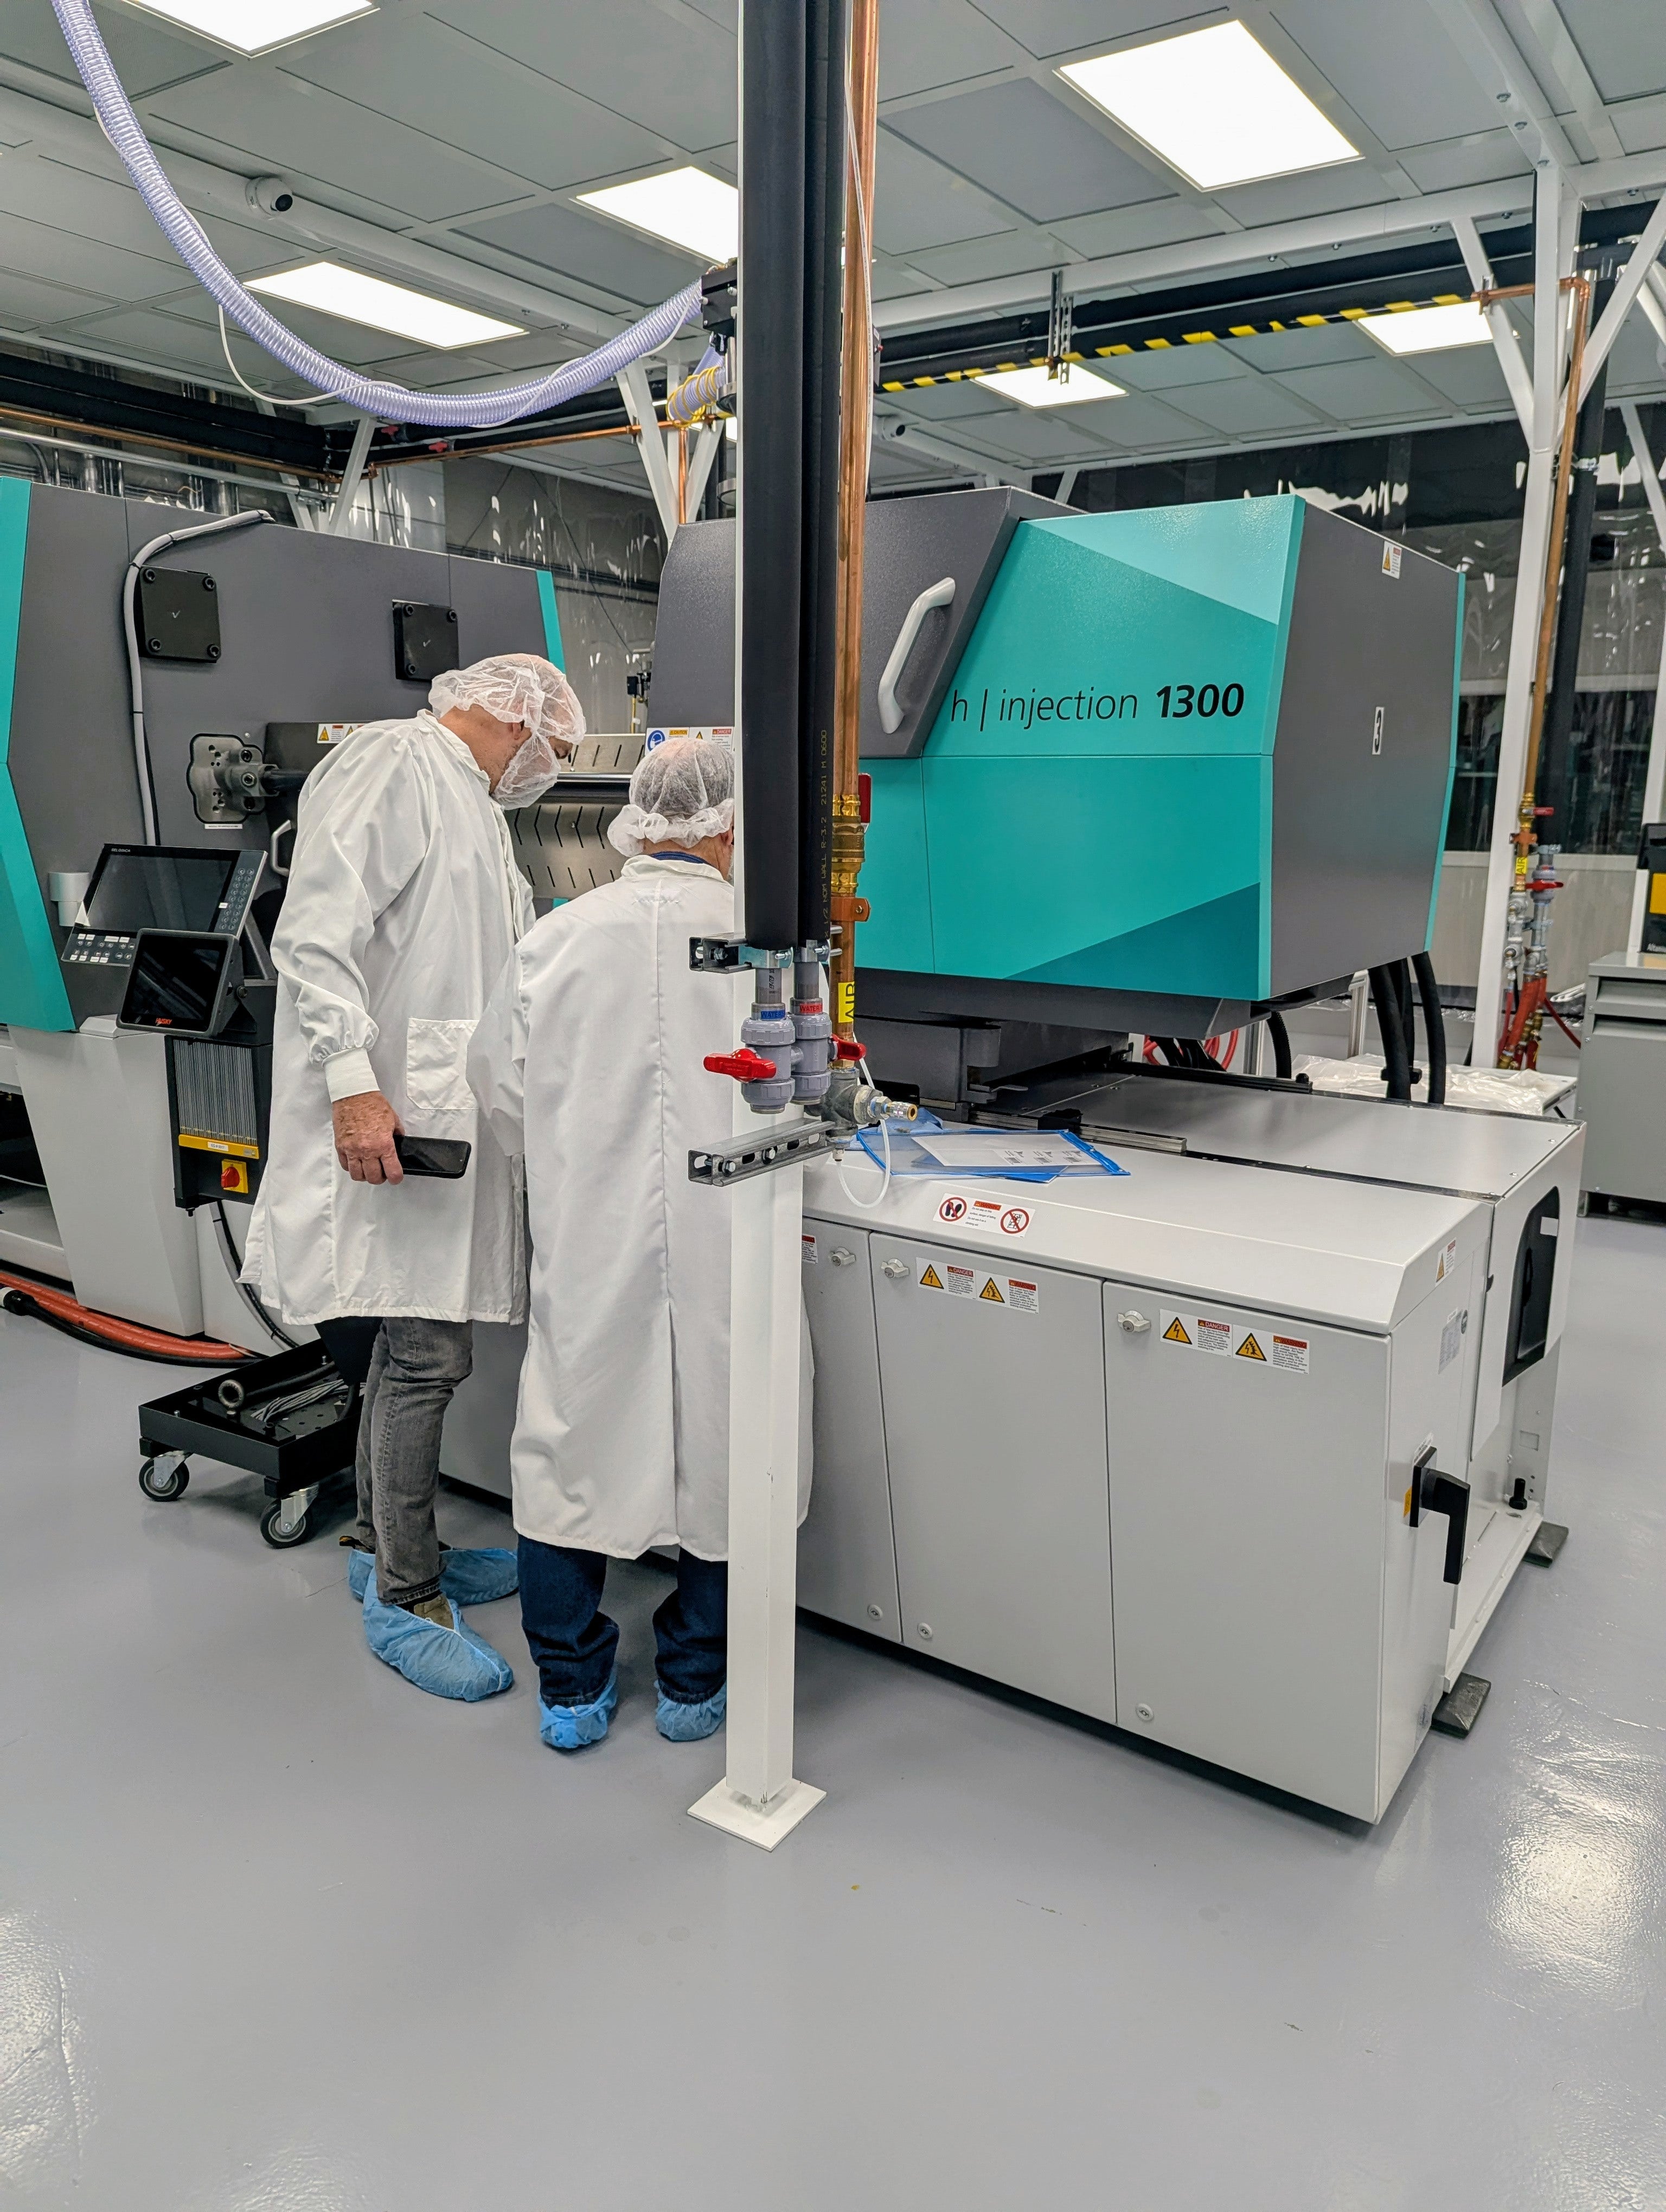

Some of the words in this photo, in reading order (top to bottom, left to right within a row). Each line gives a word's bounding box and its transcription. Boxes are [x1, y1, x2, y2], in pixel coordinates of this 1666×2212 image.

[950, 689, 968, 722] h
[999, 686, 1138, 729] injection
[1156, 683, 1245, 718] 1300
[1374, 709, 1382, 753] 3
[1516, 857, 1526, 873] AIR
[761, 1011, 781, 1019] WATER
[953, 1268, 972, 1276] DANGER
[1205, 1321, 1229, 1332] DANGER
